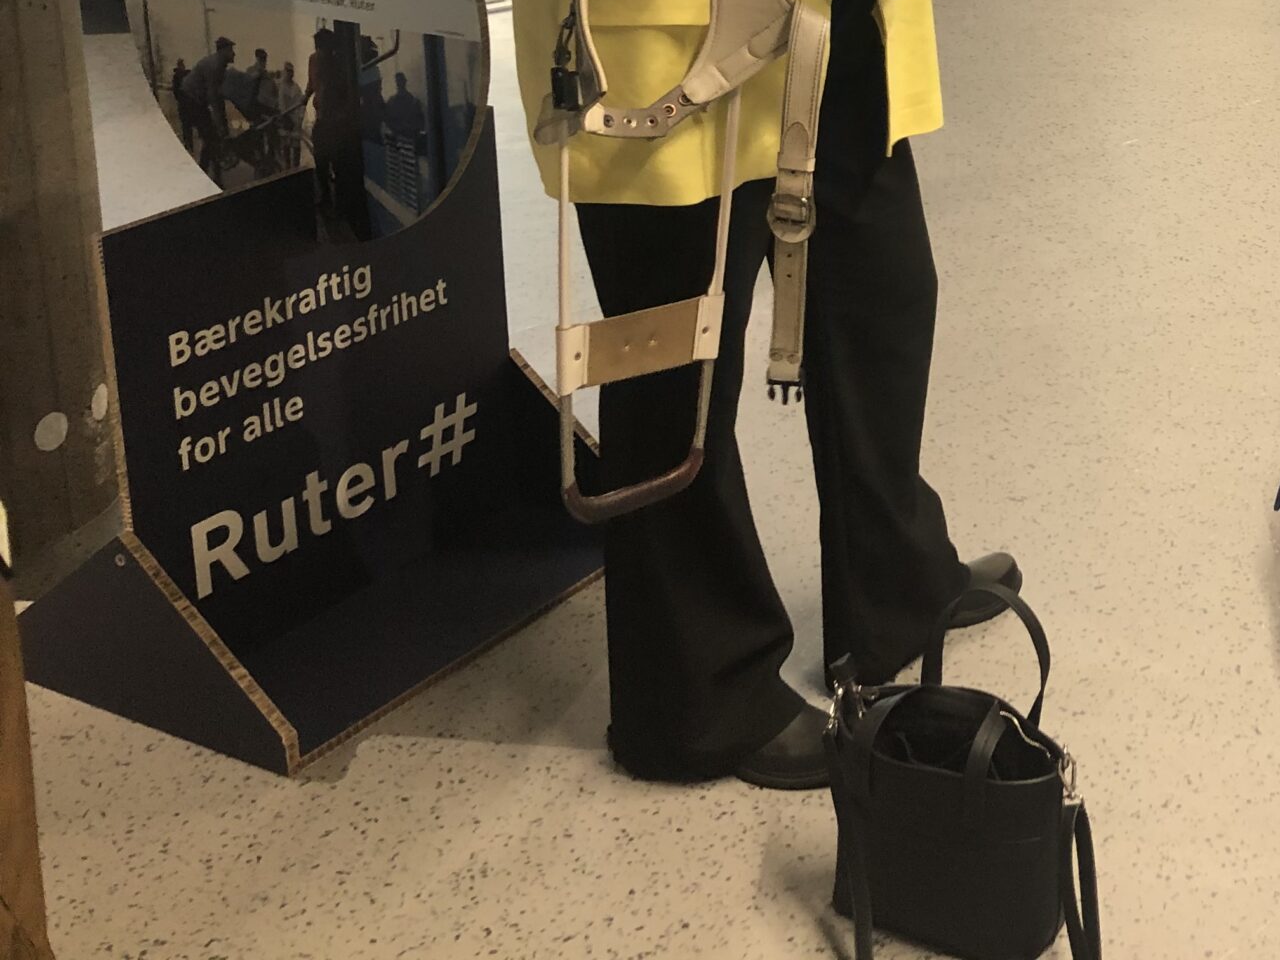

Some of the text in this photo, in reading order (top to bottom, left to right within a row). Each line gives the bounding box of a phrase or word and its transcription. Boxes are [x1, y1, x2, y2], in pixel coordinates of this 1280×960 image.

[168, 263, 373, 368] Bærekraftig
[173, 278, 449, 421] bevegelsesfrihet
[177, 395, 305, 472] for alle
